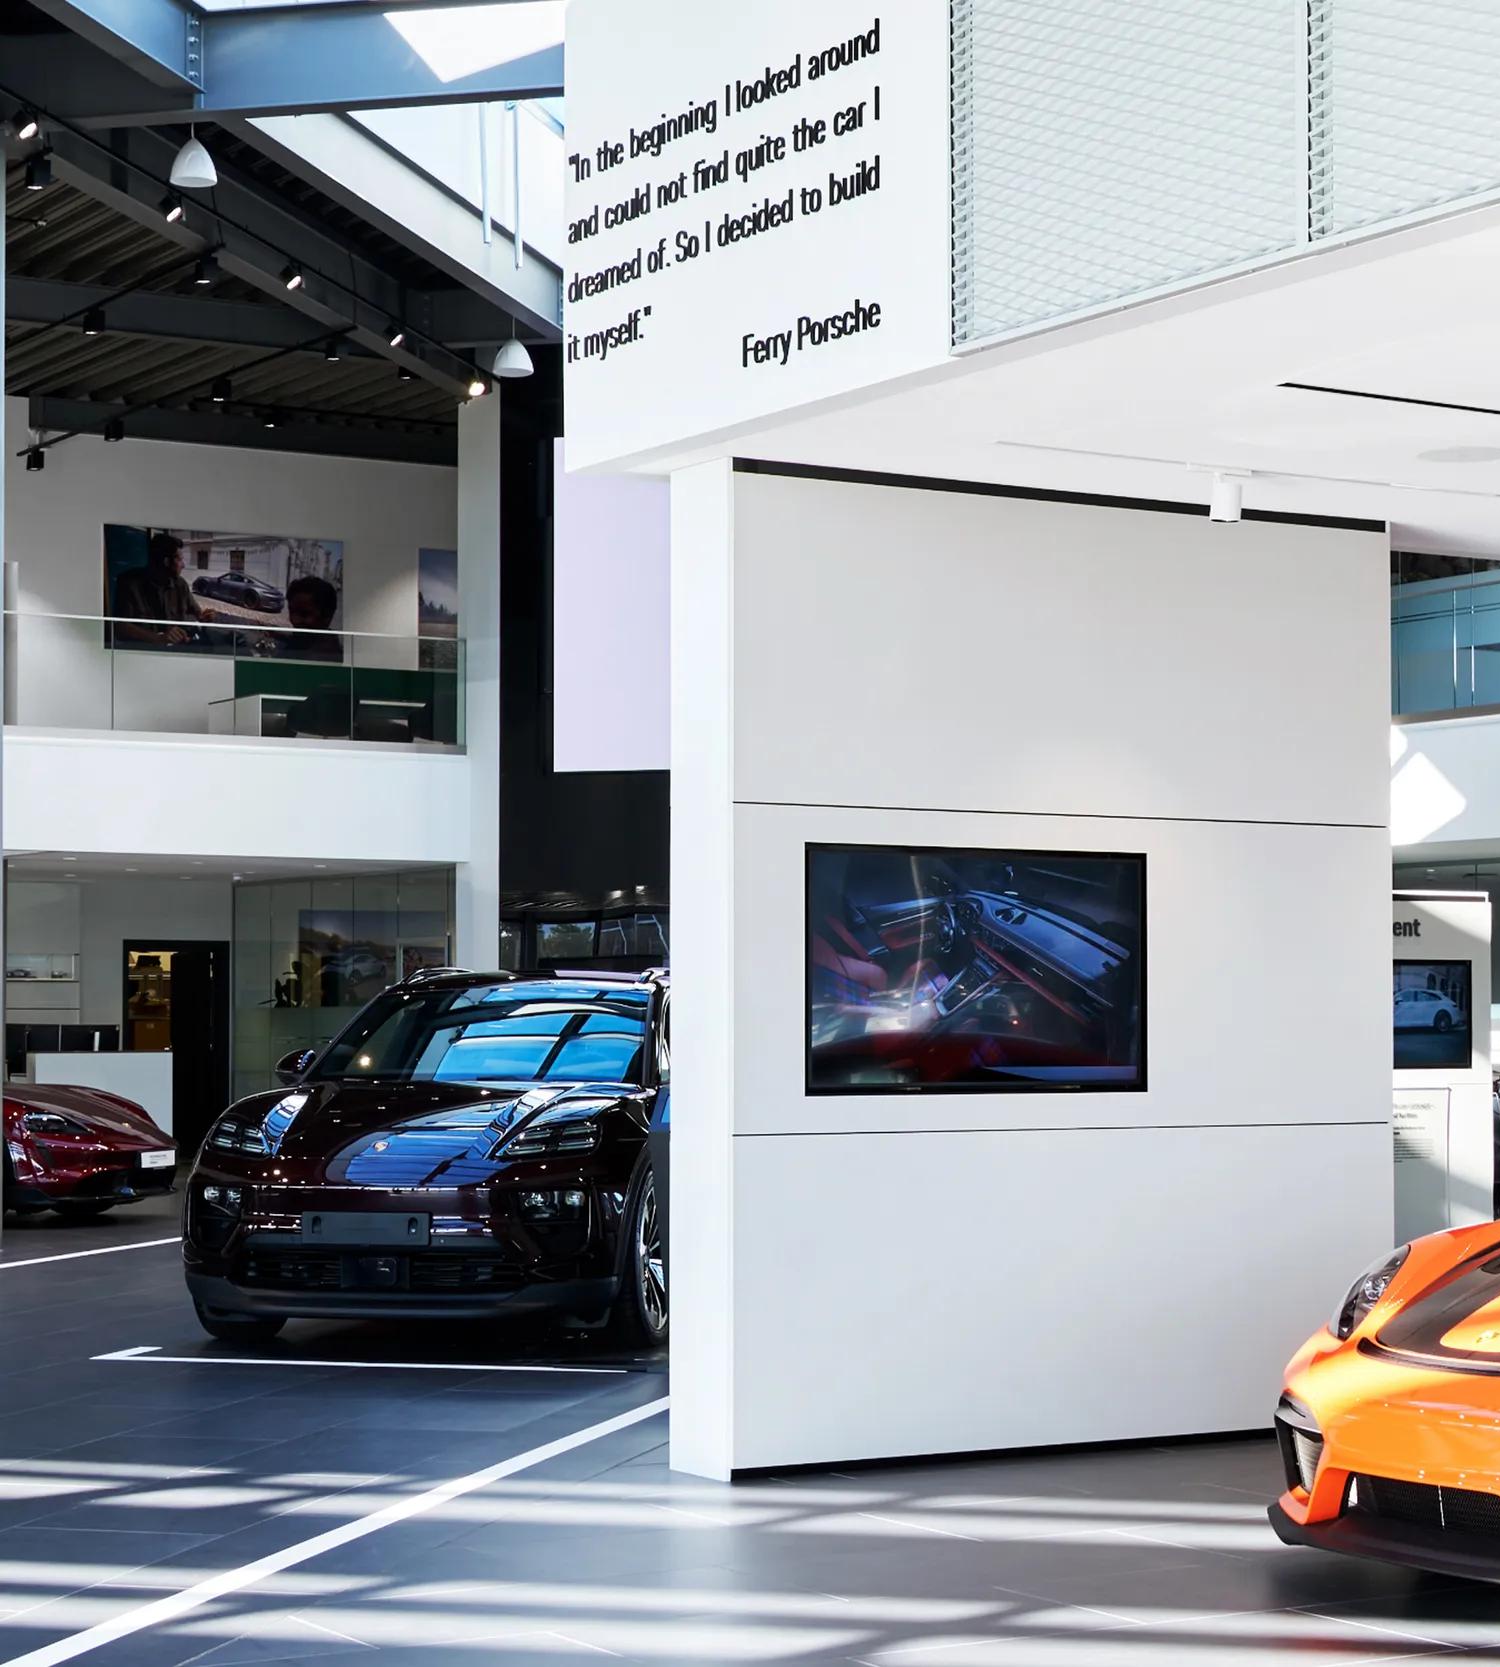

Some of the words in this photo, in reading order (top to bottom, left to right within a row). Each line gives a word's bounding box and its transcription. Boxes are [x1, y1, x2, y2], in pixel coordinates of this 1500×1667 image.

[596, 140, 625, 173] the
[629, 100, 718, 159] beginning
[725, 84, 731, 117] I
[735, 53, 801, 113] looked
[807, 17, 881, 81] around
[567, 204, 599, 245] and
[604, 182, 651, 230] could
[656, 172, 688, 209] not
[692, 149, 729, 194] find
[735, 134, 786, 184] quite
[791, 117, 827, 153] the
[833, 101, 867, 137] car
[874, 85, 881, 121] I
[567, 247, 642, 304] dreamed
[647, 237, 671, 274] of.
[674, 230, 700, 263] So
[705, 220, 711, 253] I
[716, 188, 794, 247] decided
[799, 187, 823, 216] to
[828, 154, 881, 207] build
[567, 333, 581, 364] it
[583, 305, 652, 361] myself."
[742, 329, 793, 368] Ferry
[797, 298, 882, 351] Porsche
[1392, 917, 1421, 938] ent
